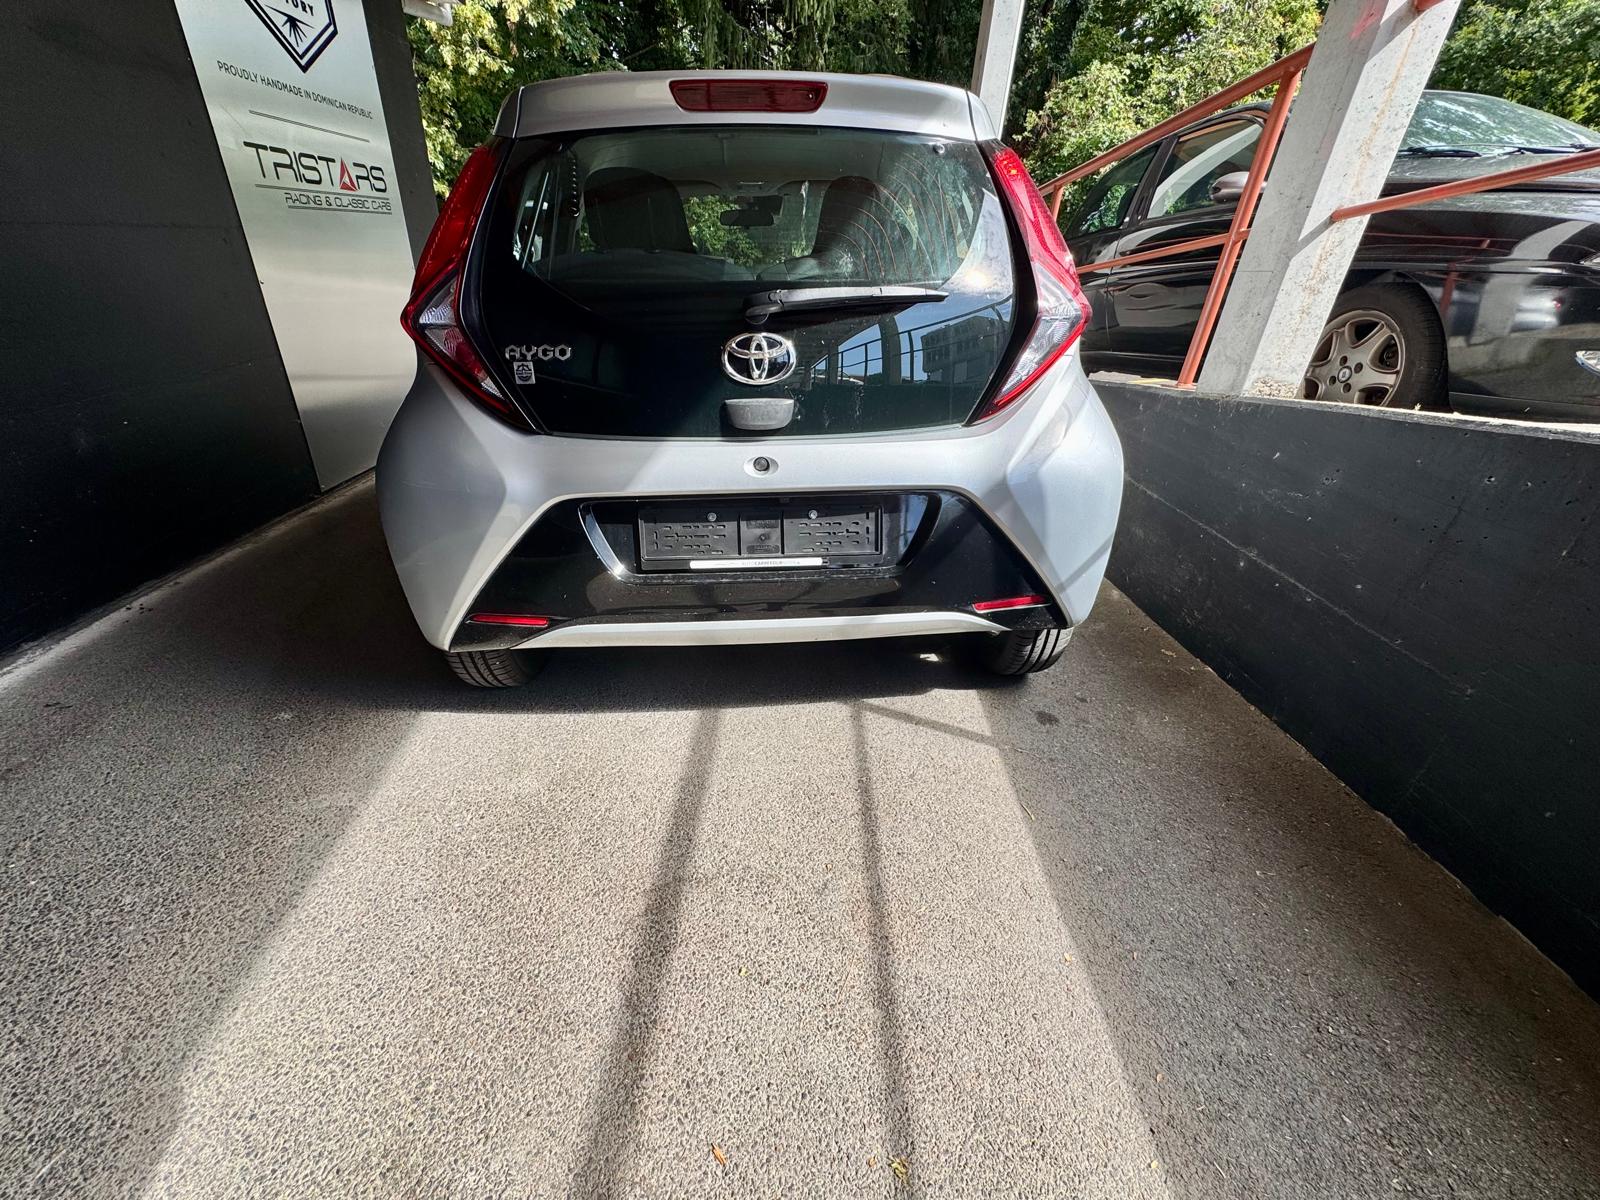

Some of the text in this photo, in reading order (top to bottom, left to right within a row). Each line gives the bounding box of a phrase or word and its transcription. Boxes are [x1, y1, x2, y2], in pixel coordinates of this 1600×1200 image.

[216, 60, 373, 120] PROUDLY HANDMADE IN DOMINICAN REPUBLIC
[243, 140, 387, 193] TRISTARS
[284, 192, 392, 211] RACING & CLASSIC CARS
[505, 344, 571, 361] AYGO
